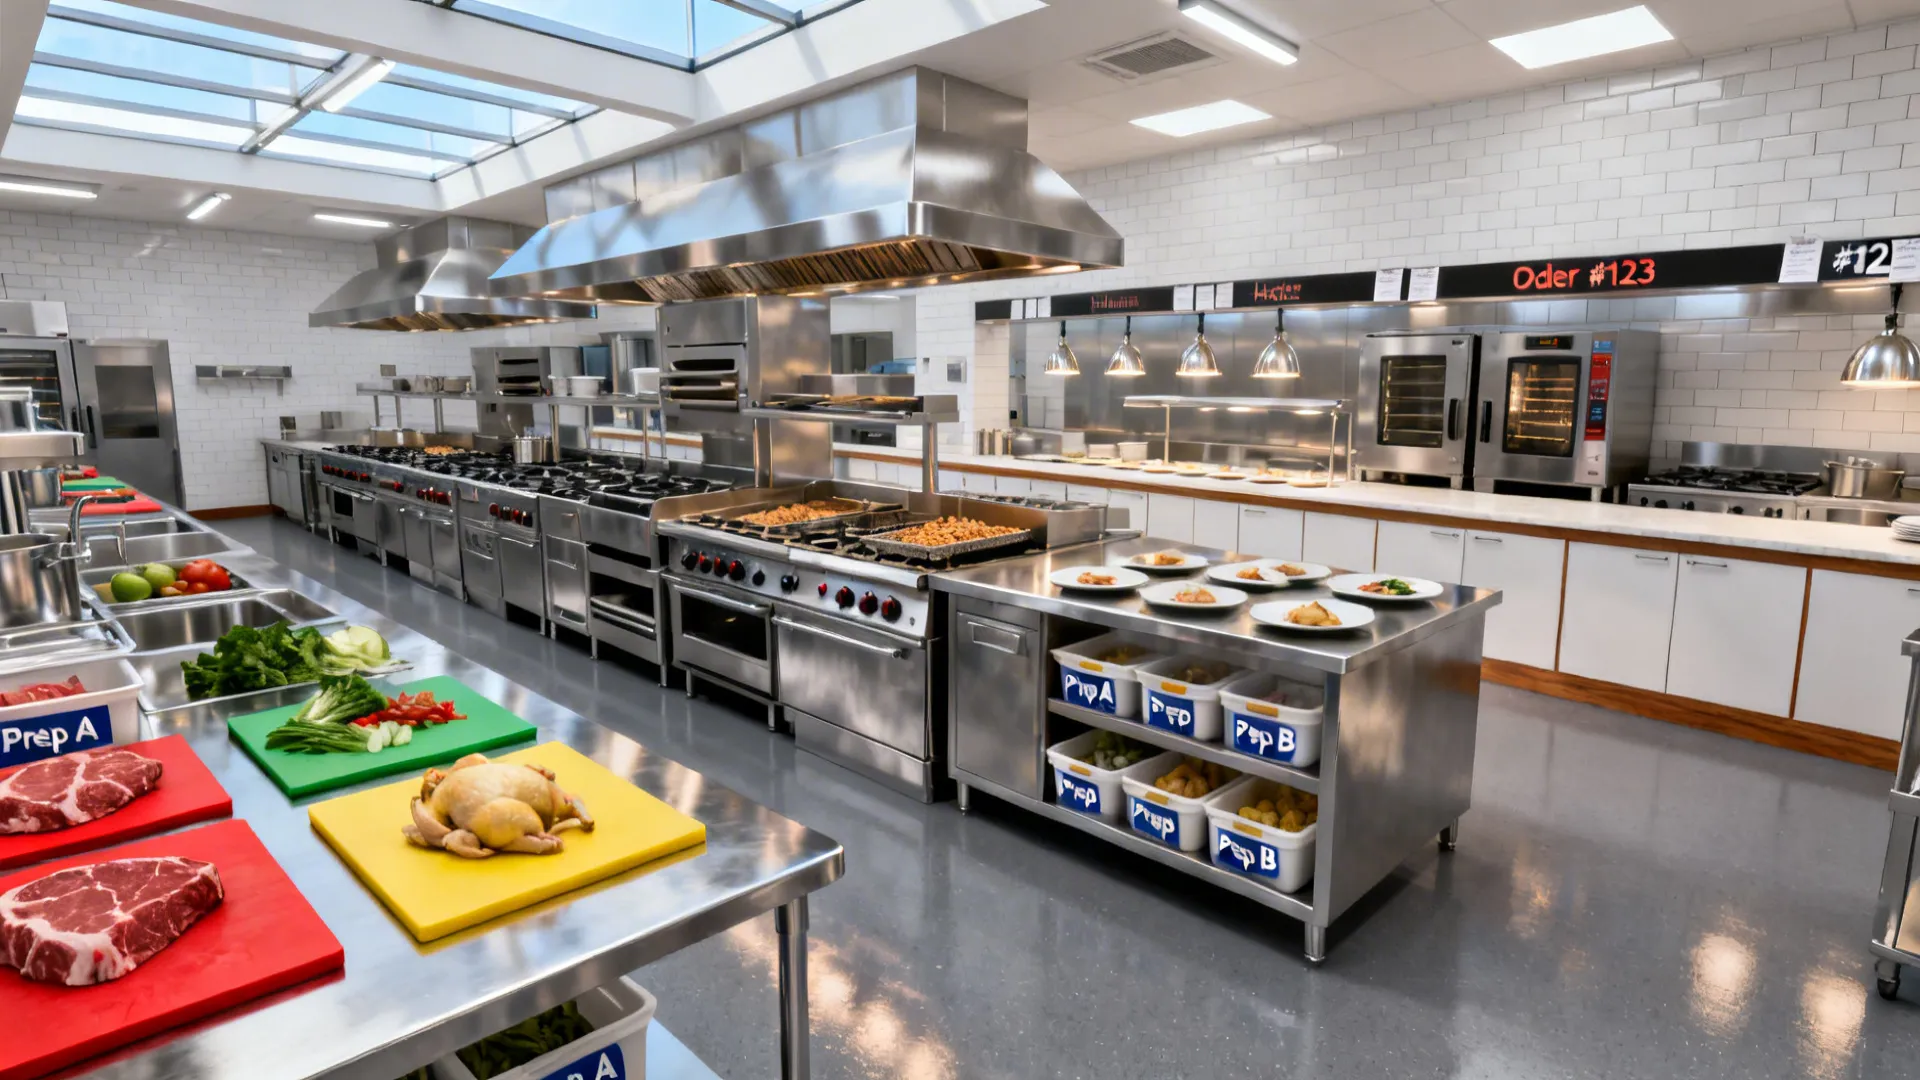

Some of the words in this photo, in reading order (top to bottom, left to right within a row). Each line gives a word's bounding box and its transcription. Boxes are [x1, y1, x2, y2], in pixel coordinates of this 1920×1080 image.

[1513, 262, 1580, 290] Oder
[1589, 257, 1656, 288] #123
[2, 727, 69, 754] Prep
[75, 715, 99, 743] A
[1277, 726, 1295, 752] B
[1260, 845, 1277, 870] B
[594, 1052, 618, 1080] A
